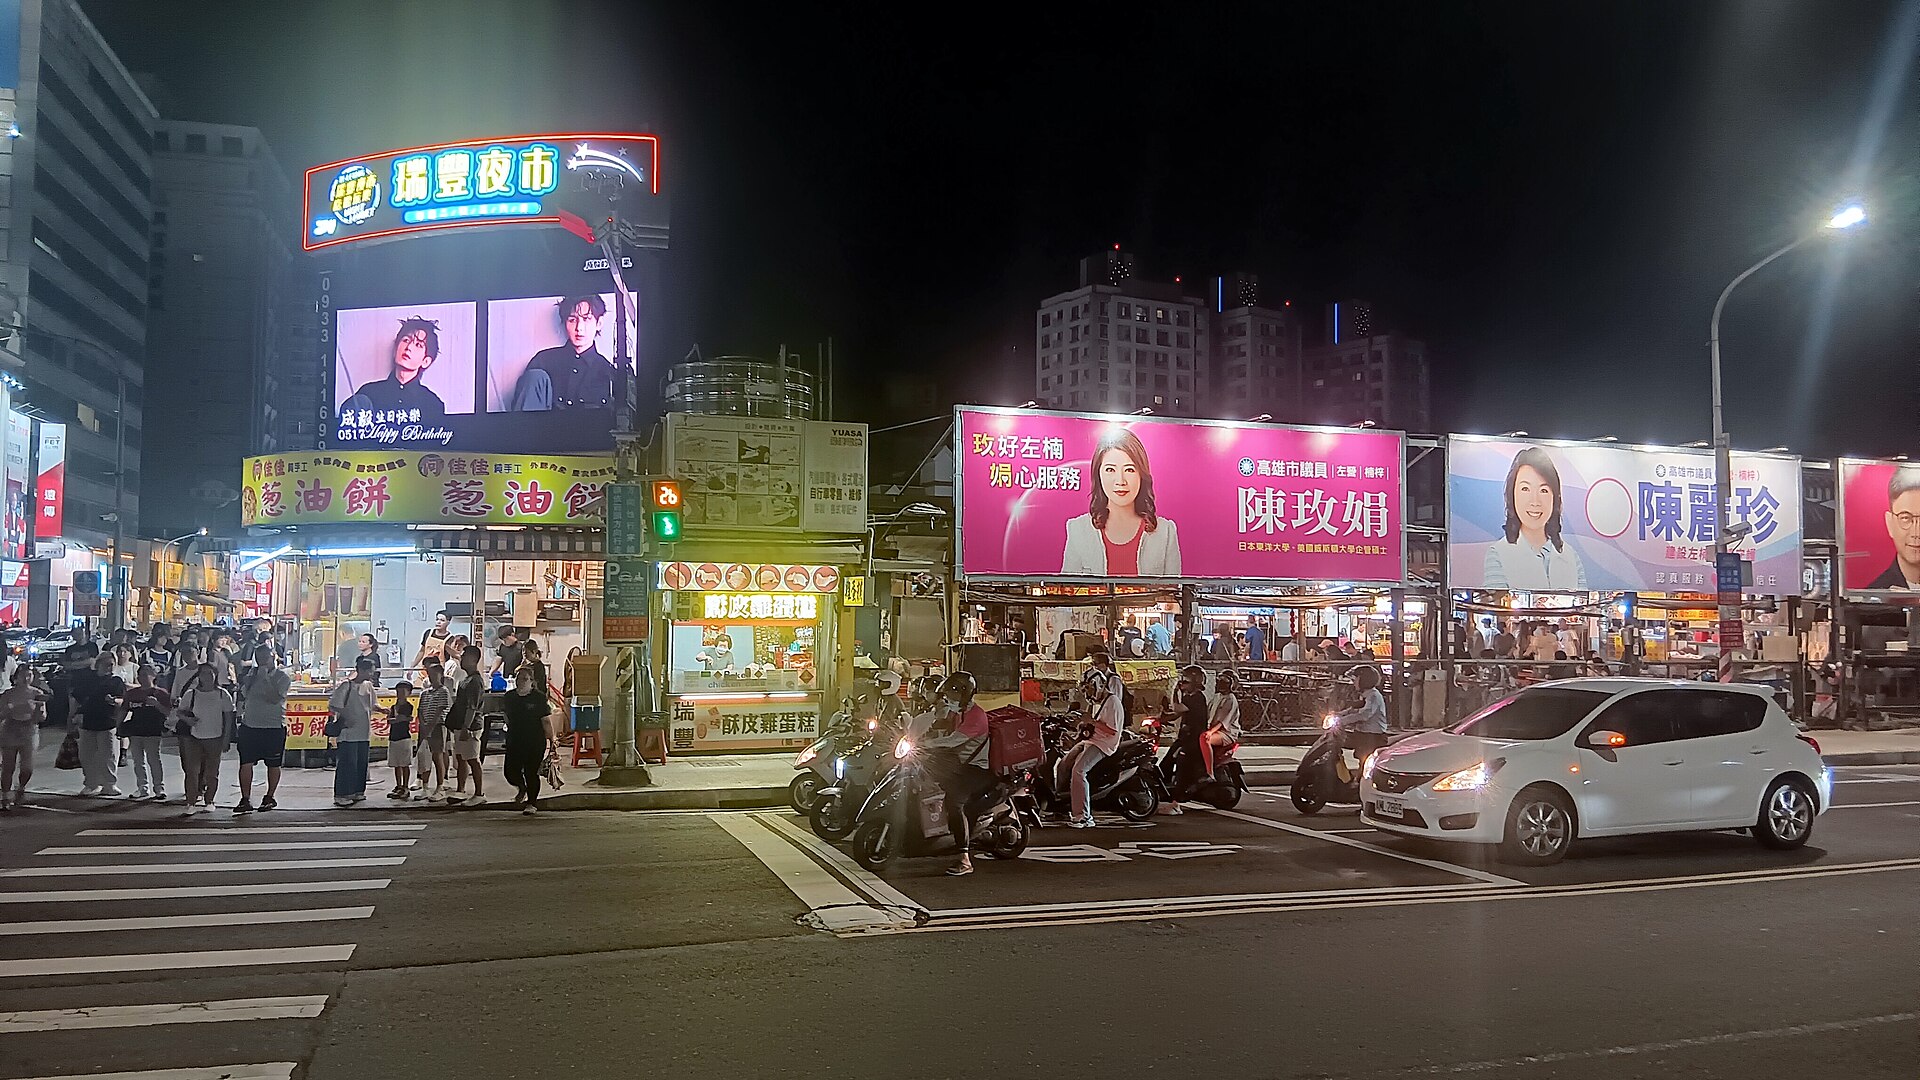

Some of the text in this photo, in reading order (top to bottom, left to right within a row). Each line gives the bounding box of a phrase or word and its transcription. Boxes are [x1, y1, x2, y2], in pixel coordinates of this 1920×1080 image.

[393, 145, 555, 204] 瑞豐夜市
[338, 424, 454, 445] 0517 Happy Birthday
[832, 429, 863, 437] YUASA
[972, 433, 1065, 460] 玫好左楠
[989, 463, 1081, 490] 娟心服務
[1256, 459, 1328, 479] 高雄市議員
[1668, 465, 1713, 480] 高雄市議員
[1237, 487, 1389, 538] 陳玫娟
[1637, 480, 1781, 545] 陳麗珍
[606, 562, 620, 582] P
[673, 700, 695, 749] 瑞豐
[721, 712, 816, 736] 酥皮雞蛋糕
